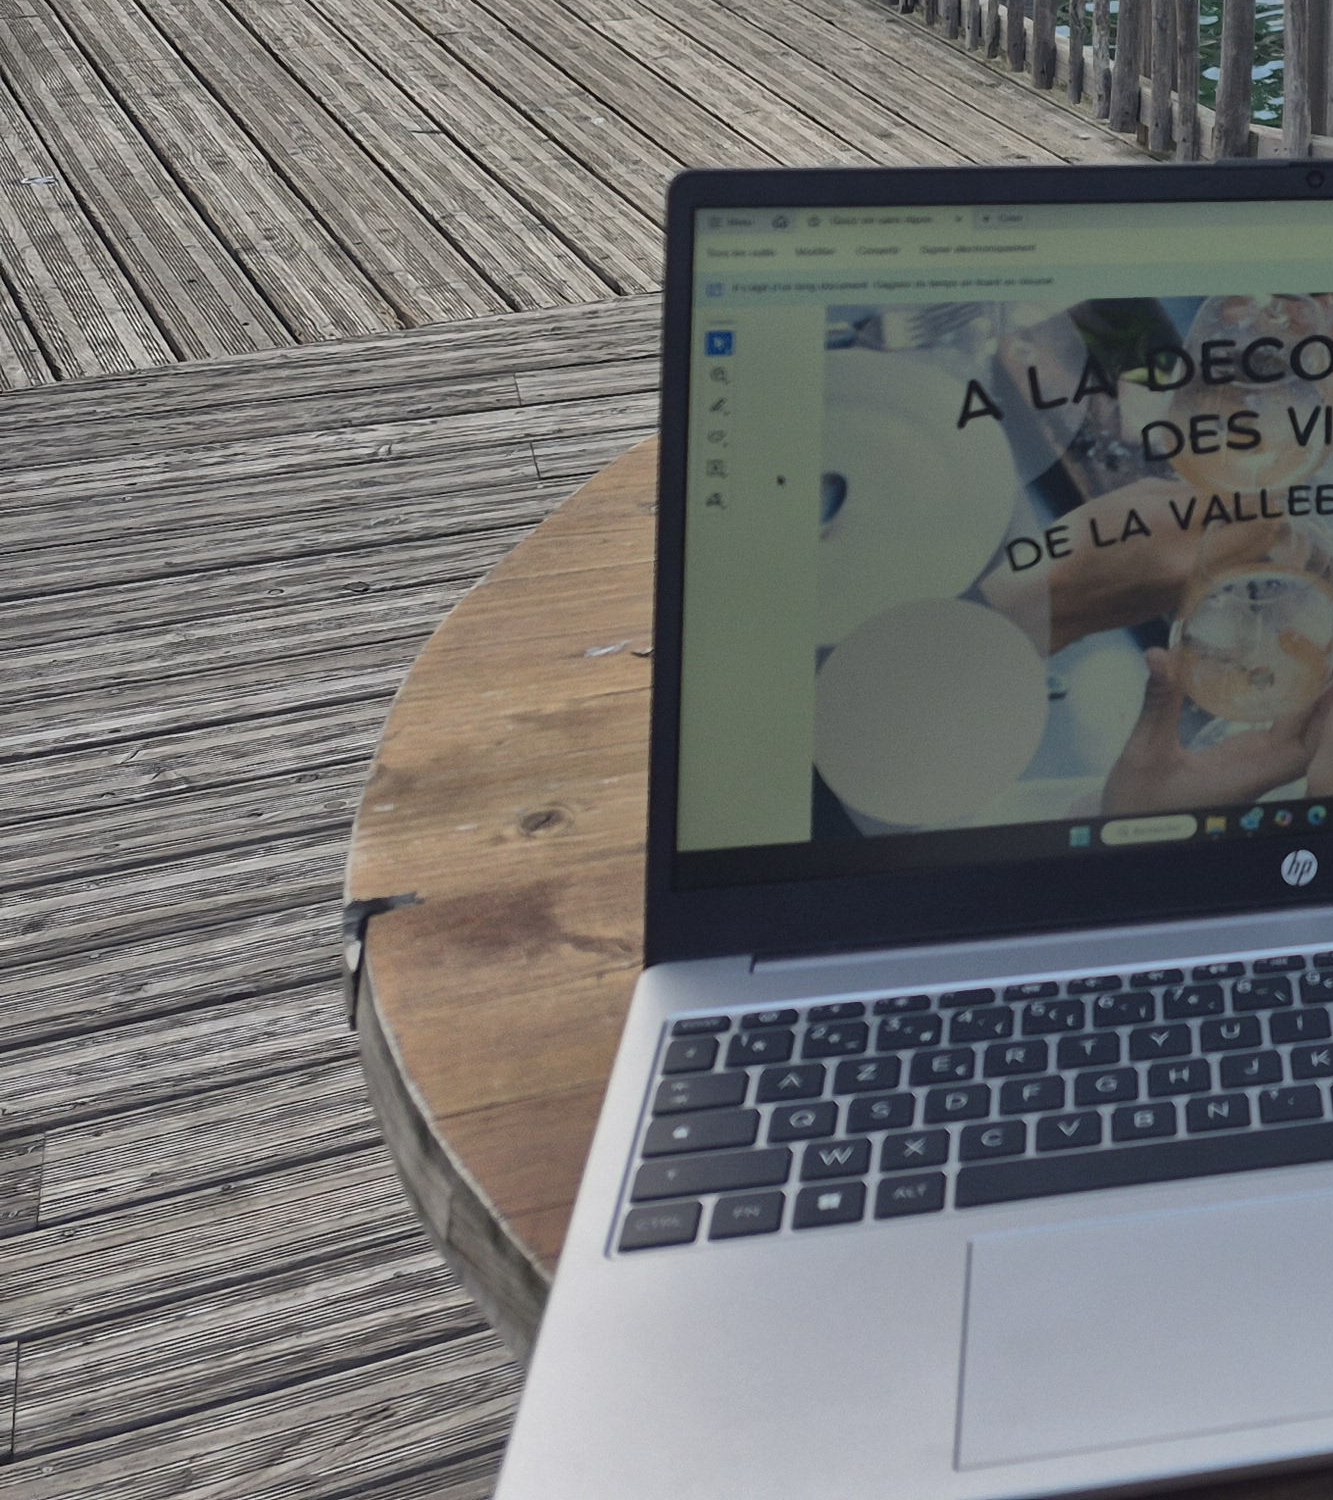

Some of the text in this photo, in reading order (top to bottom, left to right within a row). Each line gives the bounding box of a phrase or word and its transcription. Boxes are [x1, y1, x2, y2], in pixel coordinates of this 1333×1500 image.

[957, 379, 1003, 430] A
[1028, 360, 1120, 411] LA
[1141, 410, 1262, 462] DES
[1006, 525, 1073, 572] DE
[1089, 507, 1152, 547] LA
[1283, 851, 1317, 886] hp
[777, 1072, 800, 1089] A
[856, 1063, 878, 1081] Z
[932, 1055, 951, 1072] E
[1005, 1047, 1025, 1065] R
[1081, 1038, 1098, 1056] T
[1150, 1030, 1170, 1047] Y
[1220, 1022, 1241, 1039] U
[789, 1110, 816, 1129] Q
[870, 1101, 891, 1119] S
[945, 1091, 969, 1111] D
[1022, 1083, 1042, 1100] F
[1095, 1075, 1118, 1092] G
[1168, 1066, 1190, 1084] H
[1311, 1049, 1331, 1068] K
[819, 1101, 1230, 1166] W X C V B N
